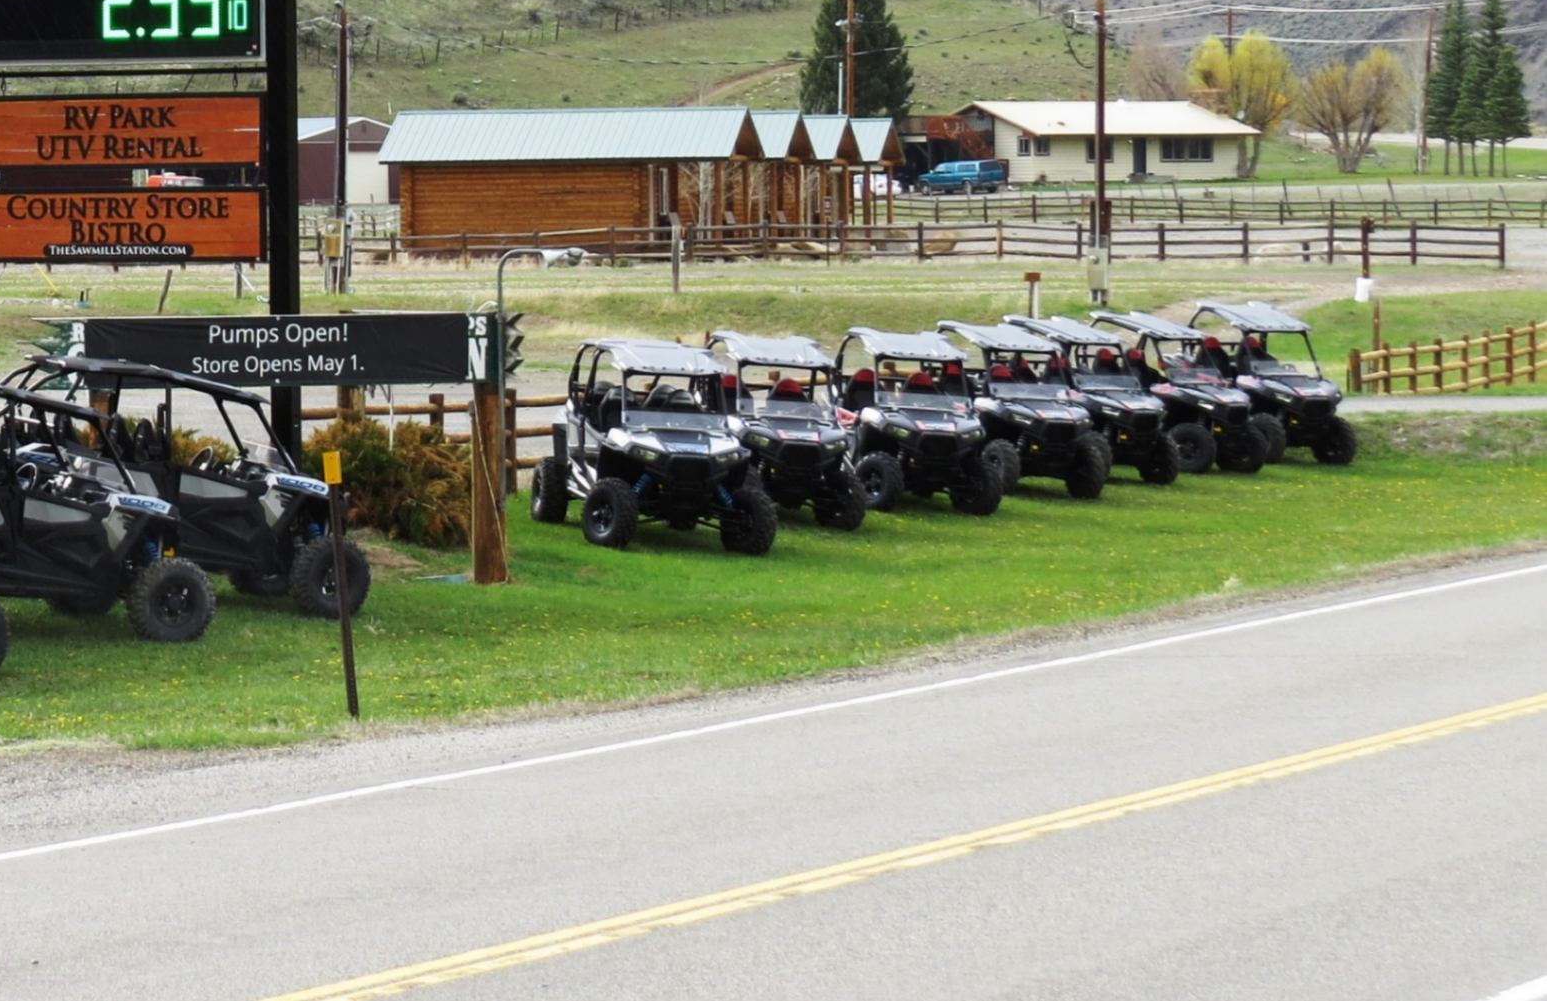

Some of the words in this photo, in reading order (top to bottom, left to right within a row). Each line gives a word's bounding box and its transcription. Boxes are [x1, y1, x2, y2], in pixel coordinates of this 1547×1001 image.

[64, 106, 101, 130] RV
[109, 105, 175, 129] PARK
[37, 136, 94, 160] UTV
[104, 135, 202, 160] RENTAL
[7, 195, 138, 220] COUNTRY
[146, 193, 229, 219] STORE
[70, 219, 166, 245] BISTRO
[208, 325, 280, 345] Pumps
[285, 322, 348, 345] Open!
[192, 356, 239, 374] Store
[244, 355, 302, 377] Opens
[307, 355, 347, 375] May
[350, 354, 365, 372] 1.
